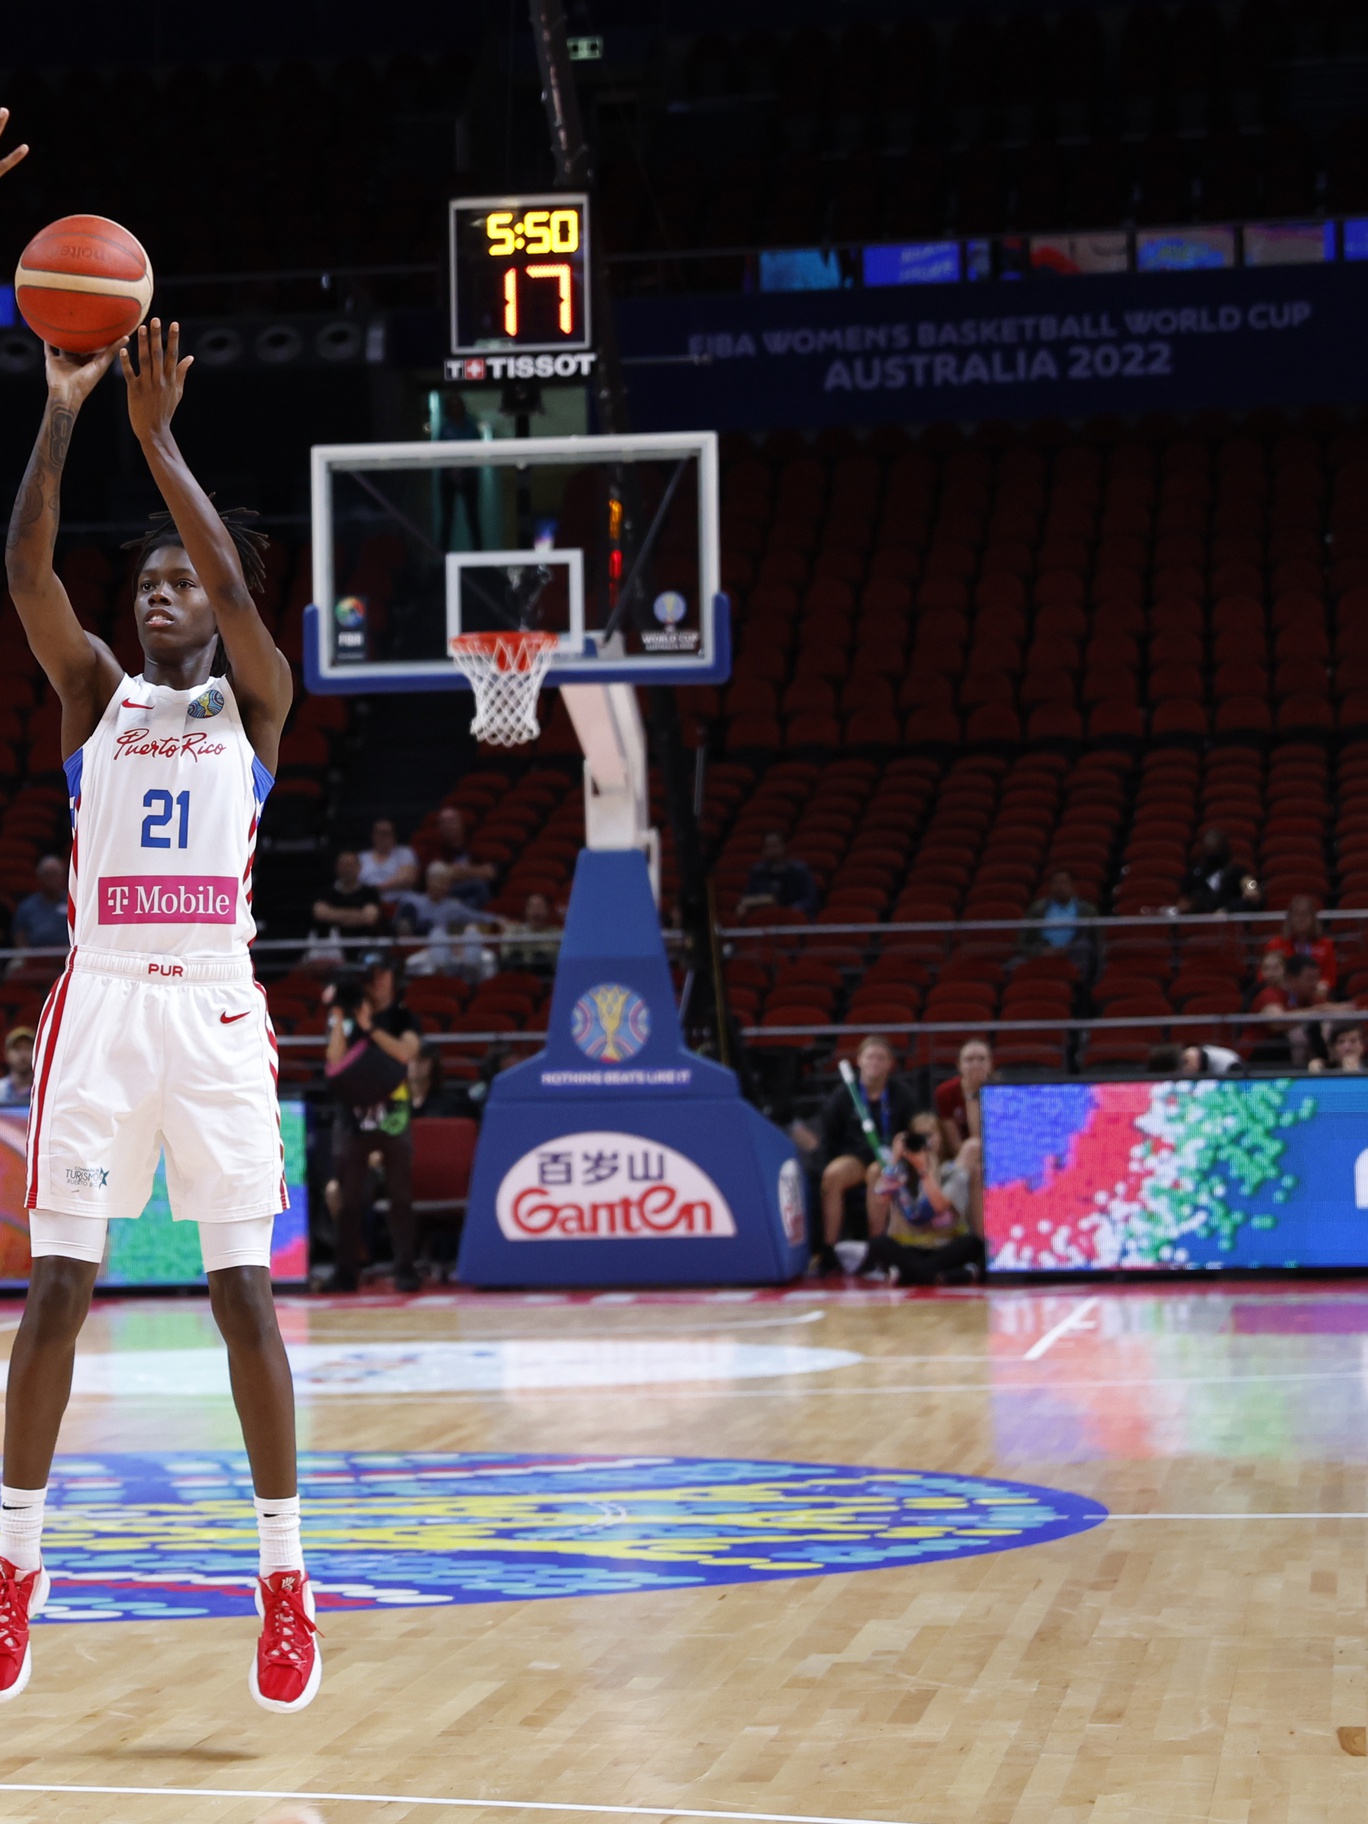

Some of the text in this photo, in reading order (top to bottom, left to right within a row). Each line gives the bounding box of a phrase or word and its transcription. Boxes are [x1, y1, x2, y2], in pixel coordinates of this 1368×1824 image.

[486, 209, 579, 256] 5:50
[503, 264, 573, 336] 17
[916, 313, 1119, 349] BASKETBALL
[1124, 304, 1242, 337] WORLD
[1247, 300, 1313, 330] CUP
[486, 352, 598, 380] TISSOT
[822, 340, 1174, 392] AUSTRALIA 2022
[113, 728, 227, 763] Puerto Rico
[140, 788, 191, 849] 21
[148, 963, 184, 977] PUR
[542, 1071, 601, 1085] NOTHING
[604, 1070, 644, 1085] BEATS
[647, 1070, 674, 1084] LIKE
[536, 1150, 665, 1187] 百岁山
